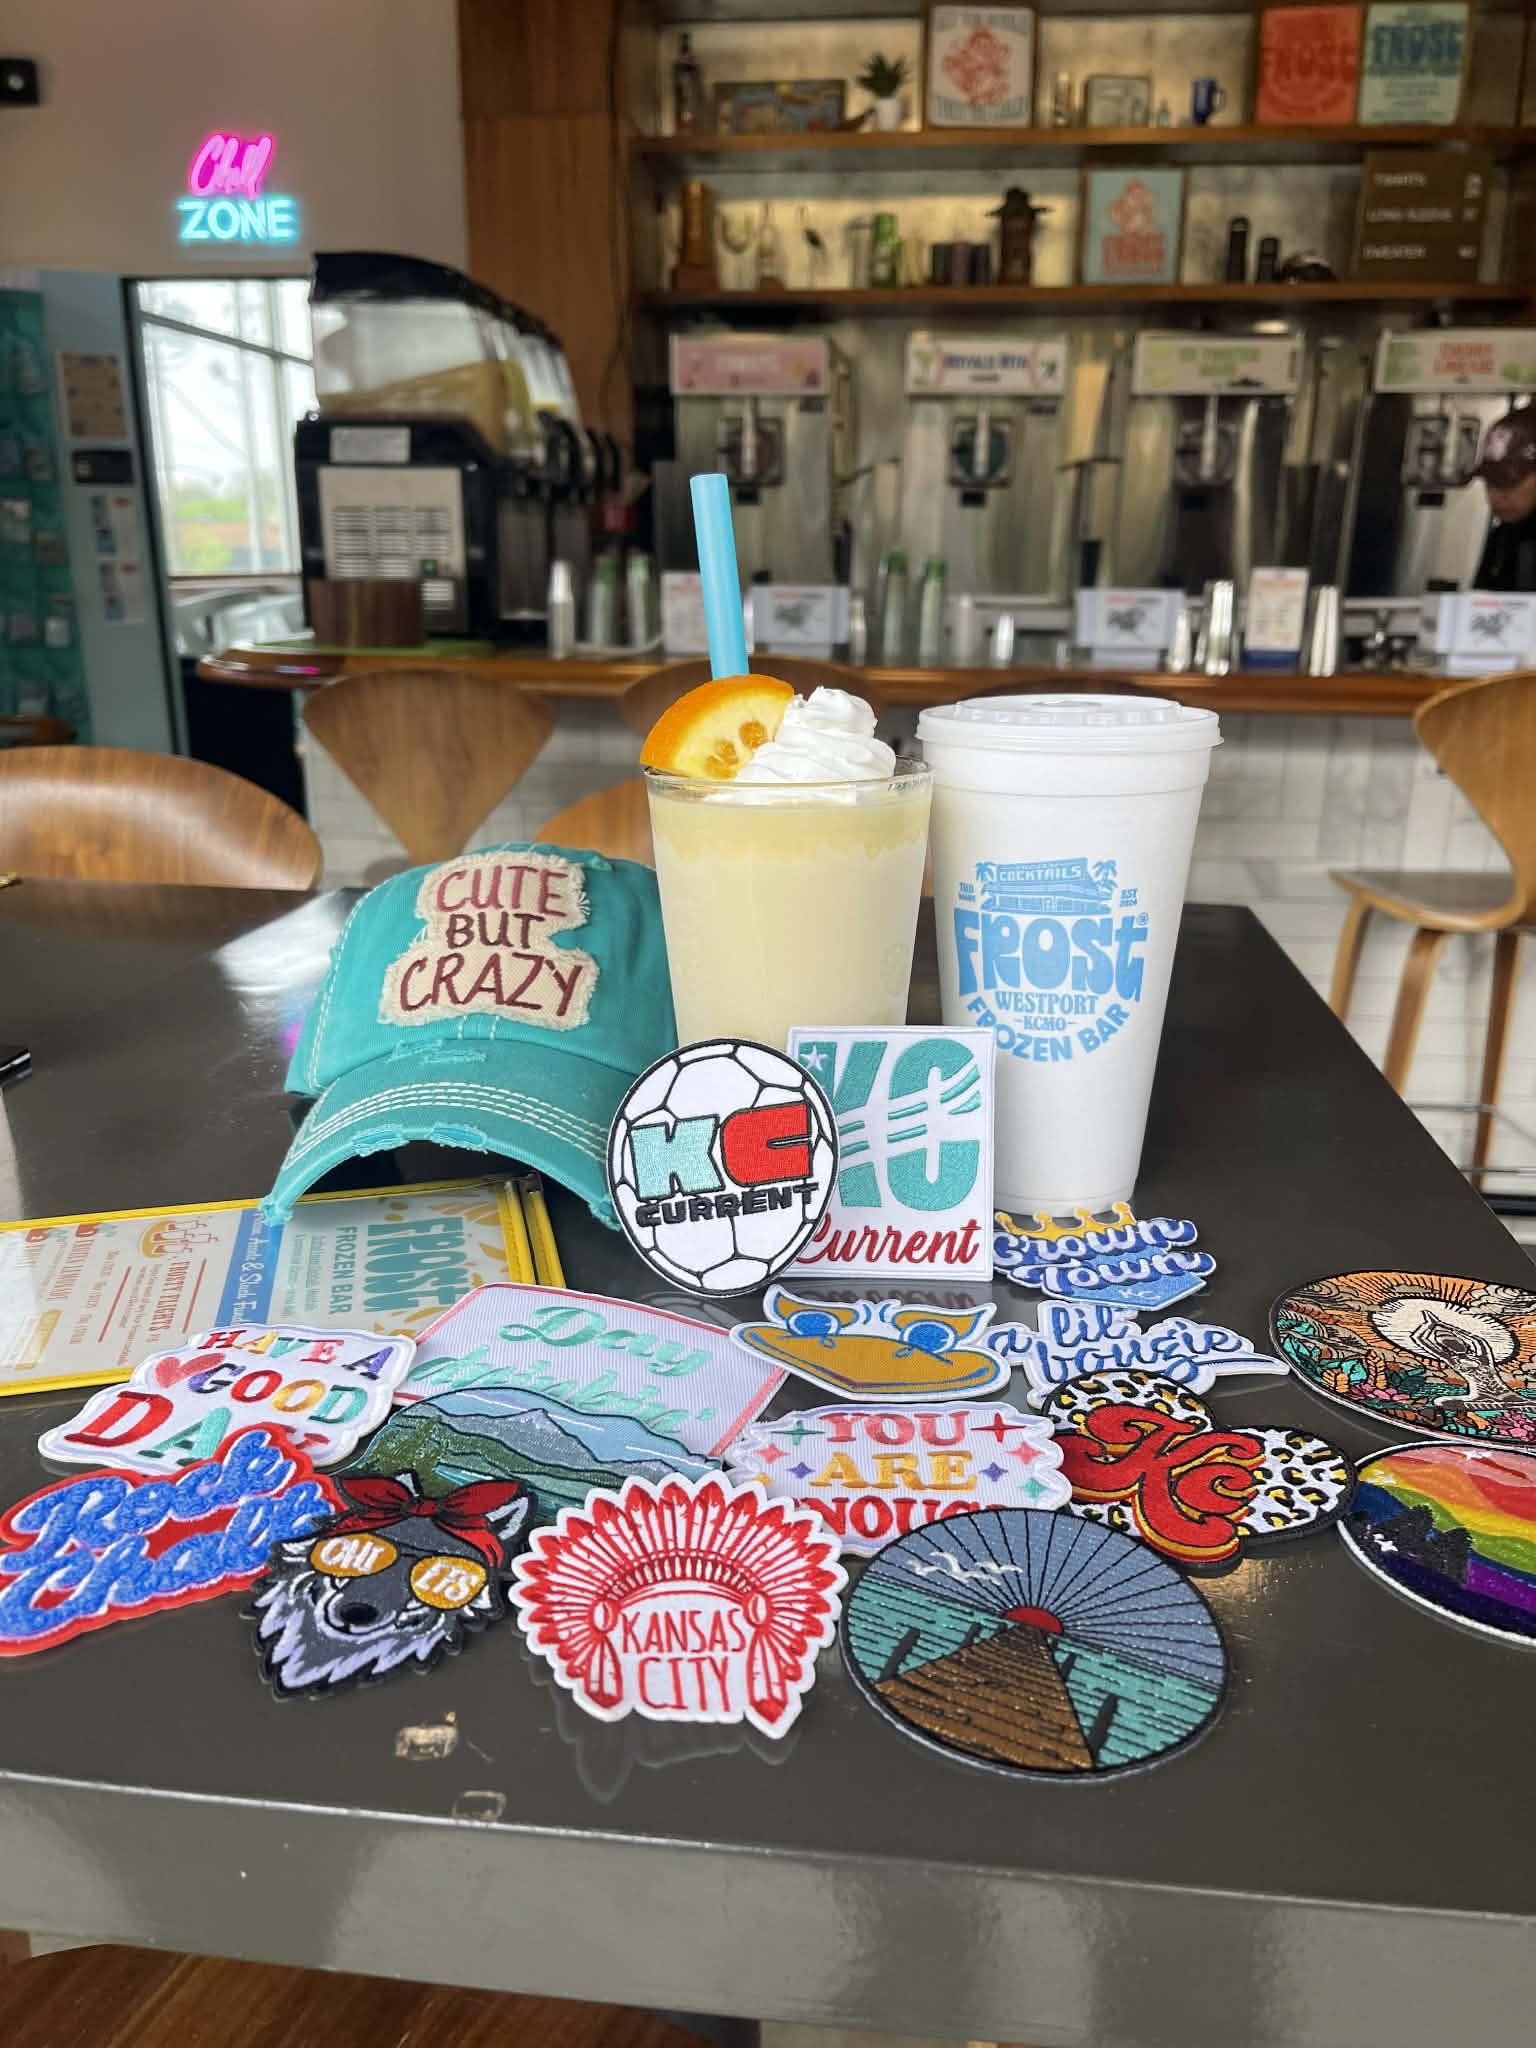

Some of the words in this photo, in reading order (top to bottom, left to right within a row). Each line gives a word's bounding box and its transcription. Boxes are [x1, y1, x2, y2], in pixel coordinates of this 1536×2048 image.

[177, 199, 296, 240] ZONE
[437, 864, 568, 917] CUTE
[1000, 864, 1082, 882] COCKTAILS
[446, 911, 545, 949] BUT
[400, 952, 583, 1017] CRAZY
[995, 990, 1099, 1015] WESTPORT
[966, 996, 1073, 1063] FROZEN
[1077, 1003, 1130, 1053] BAR
[631, 1101, 813, 1201] KC
[634, 1182, 820, 1228] CURRENT
[333, 1226, 357, 1280] FROZEN
[993, 1217, 1198, 1270] Crown
[1011, 1250, 1216, 1295] Town
[328, 1284, 353, 1314] BAR
[197, 1329, 345, 1365] HAVE
[342, 1345, 394, 1380] A
[497, 1305, 713, 1378] Day
[987, 1326, 1032, 1357] a
[187, 1362, 370, 1424] GOOD
[818, 1410, 970, 1446] YOU
[808, 1450, 977, 1491] ARE
[619, 1608, 748, 1655] KANSAS
[638, 1656, 732, 1713] CITY
